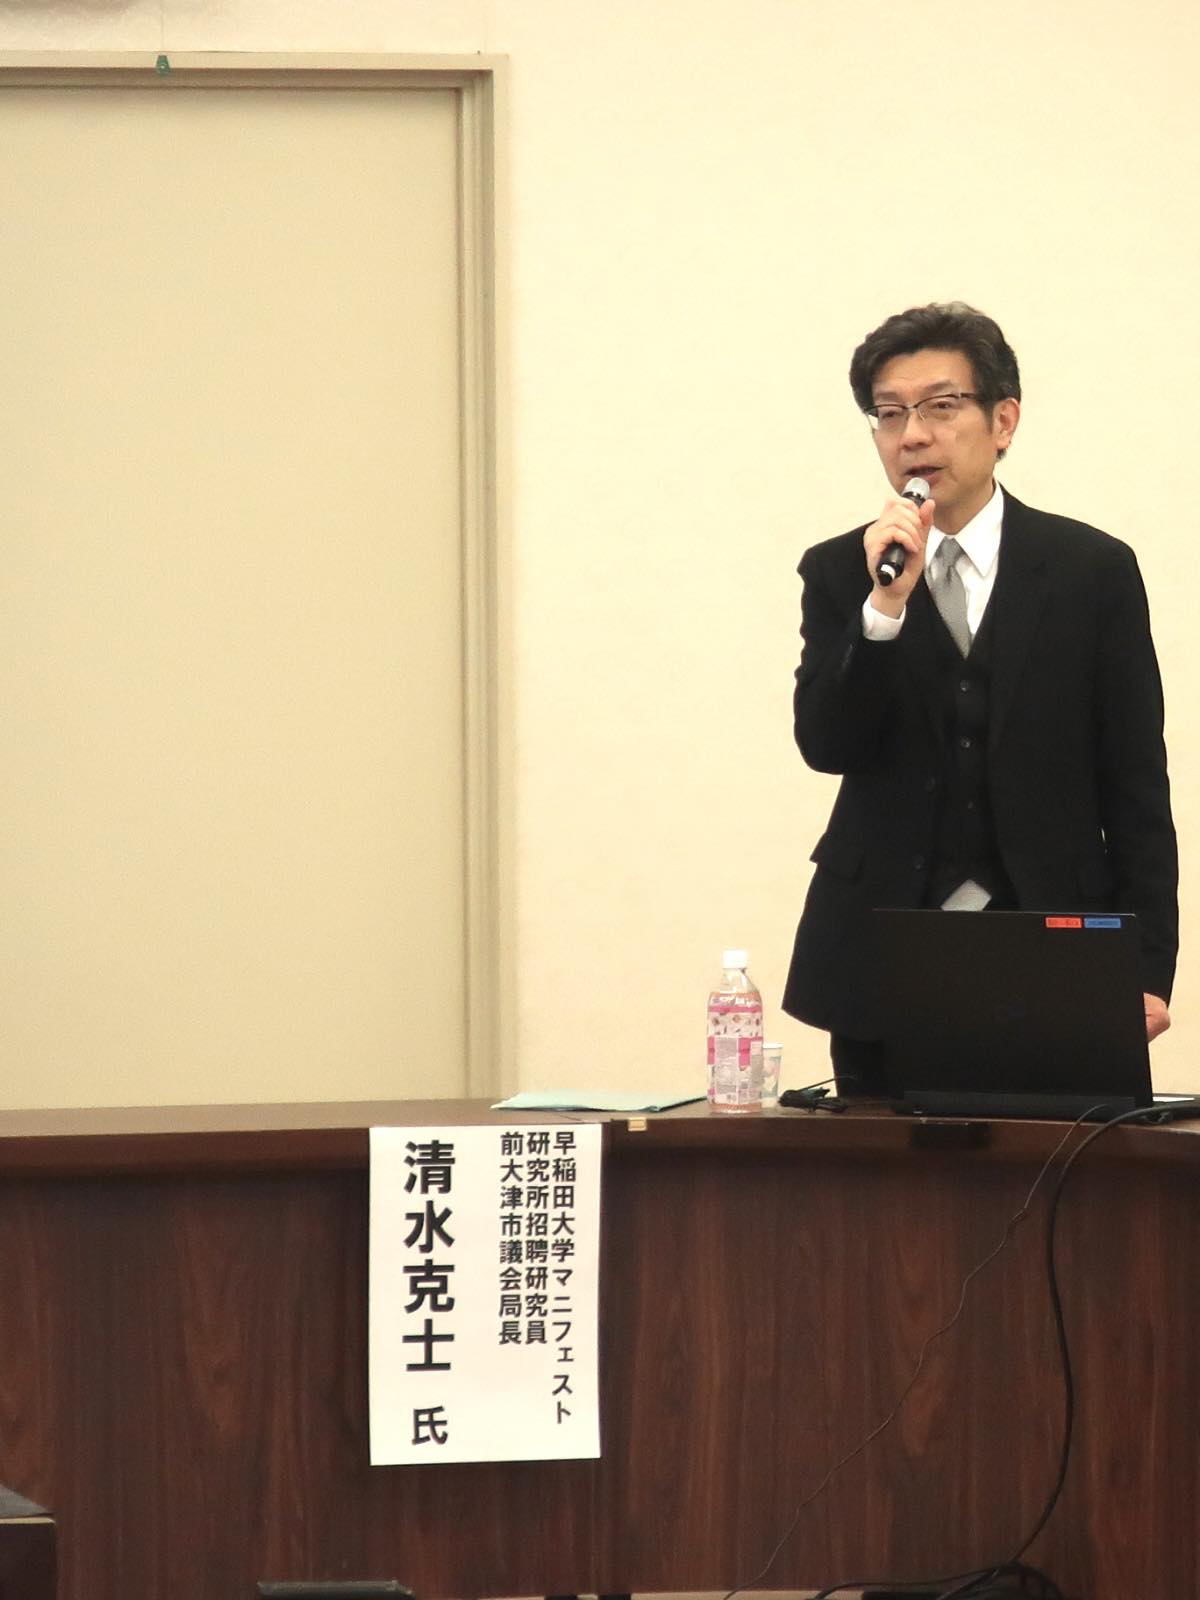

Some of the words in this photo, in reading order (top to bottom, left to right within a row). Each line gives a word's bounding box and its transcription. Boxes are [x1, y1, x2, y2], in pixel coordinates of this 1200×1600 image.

[402, 1139, 456, 1372] 清水克士
[499, 1132, 524, 1345] 前大津市議会局長
[525, 1132, 550, 1345] 研究所招聘研究員
[552, 1132, 577, 1424] 早稲田大学マニフェスト
[411, 1405, 449, 1445] 氏
